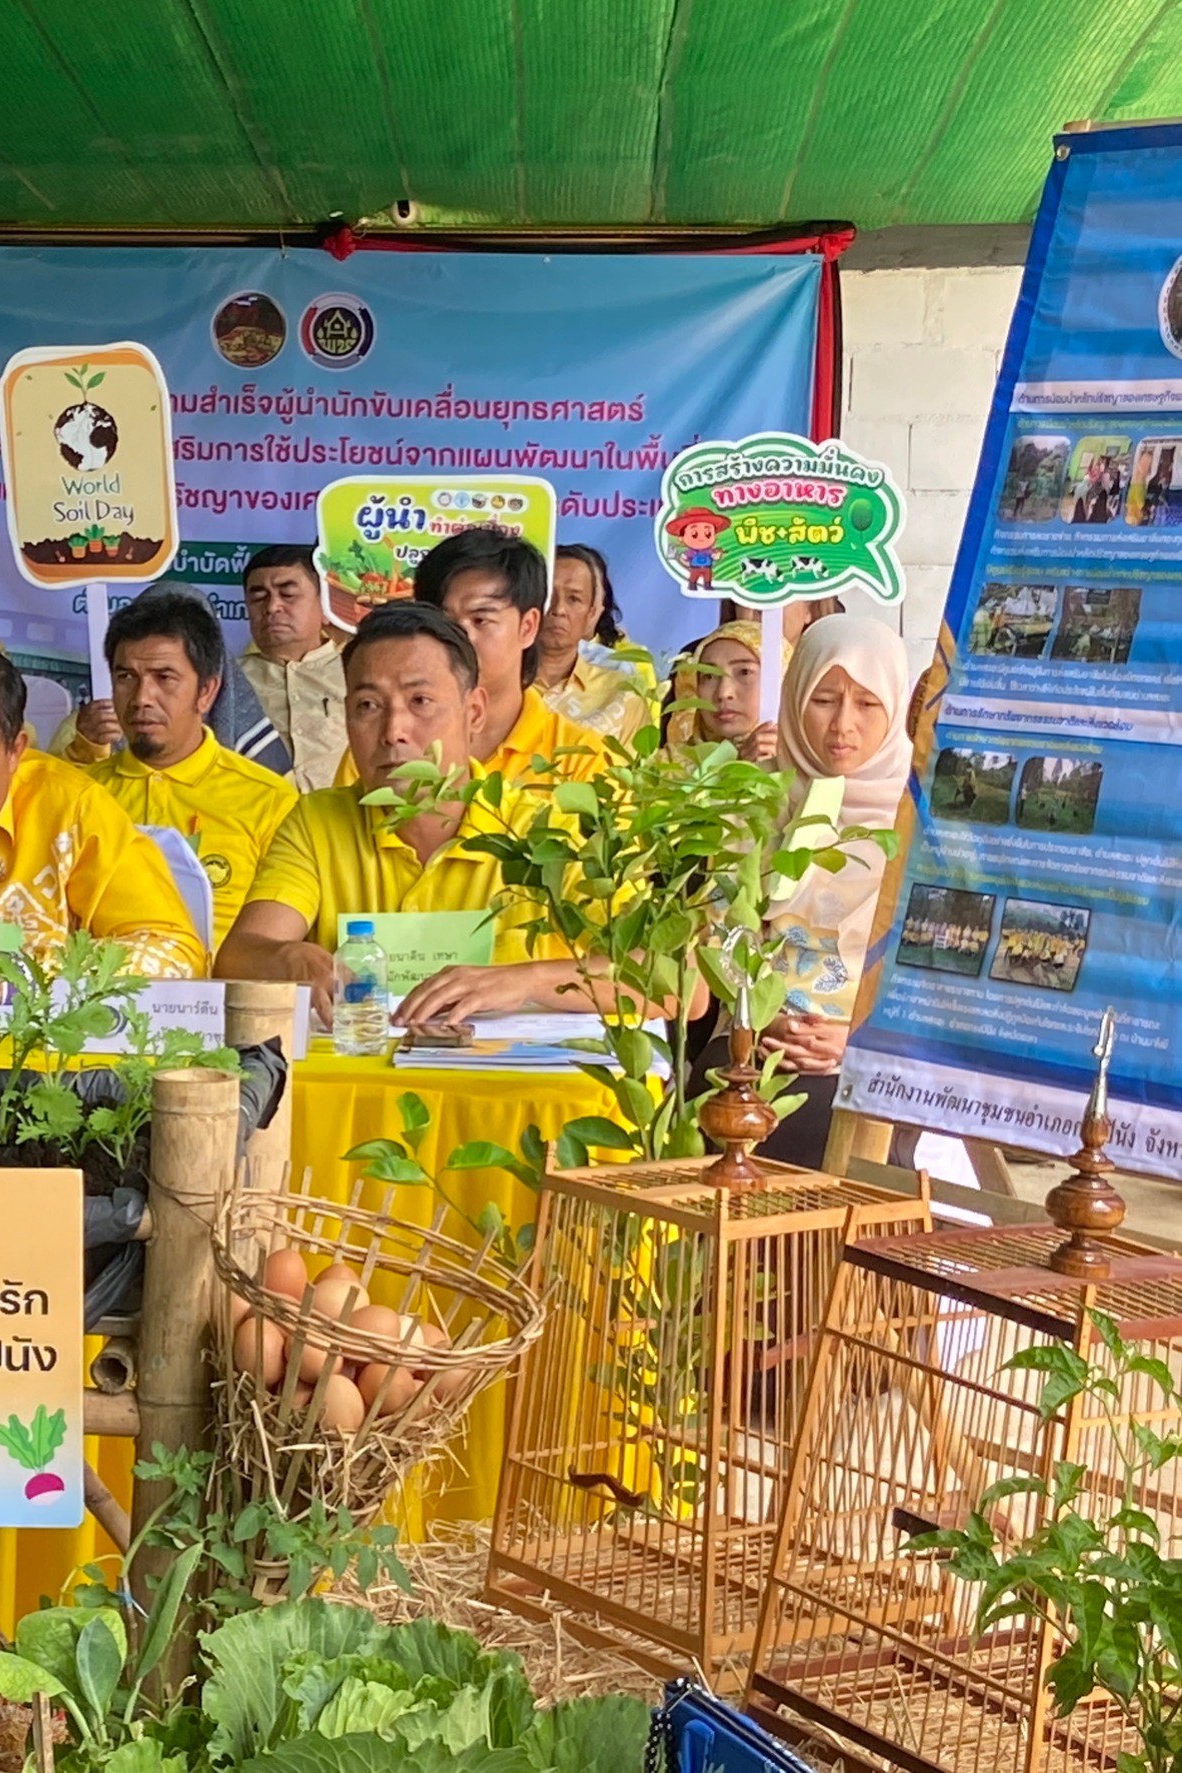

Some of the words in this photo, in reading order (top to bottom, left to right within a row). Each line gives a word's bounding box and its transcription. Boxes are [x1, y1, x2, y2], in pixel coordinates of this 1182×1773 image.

[677, 446, 881, 486] การสร้างความมั่นคง
[61, 473, 121, 495] World
[714, 480, 845, 507] ทางอาหาร
[53, 500, 91, 522] Soil
[95, 500, 135, 525] Day
[357, 495, 427, 540] ผู้นำ
